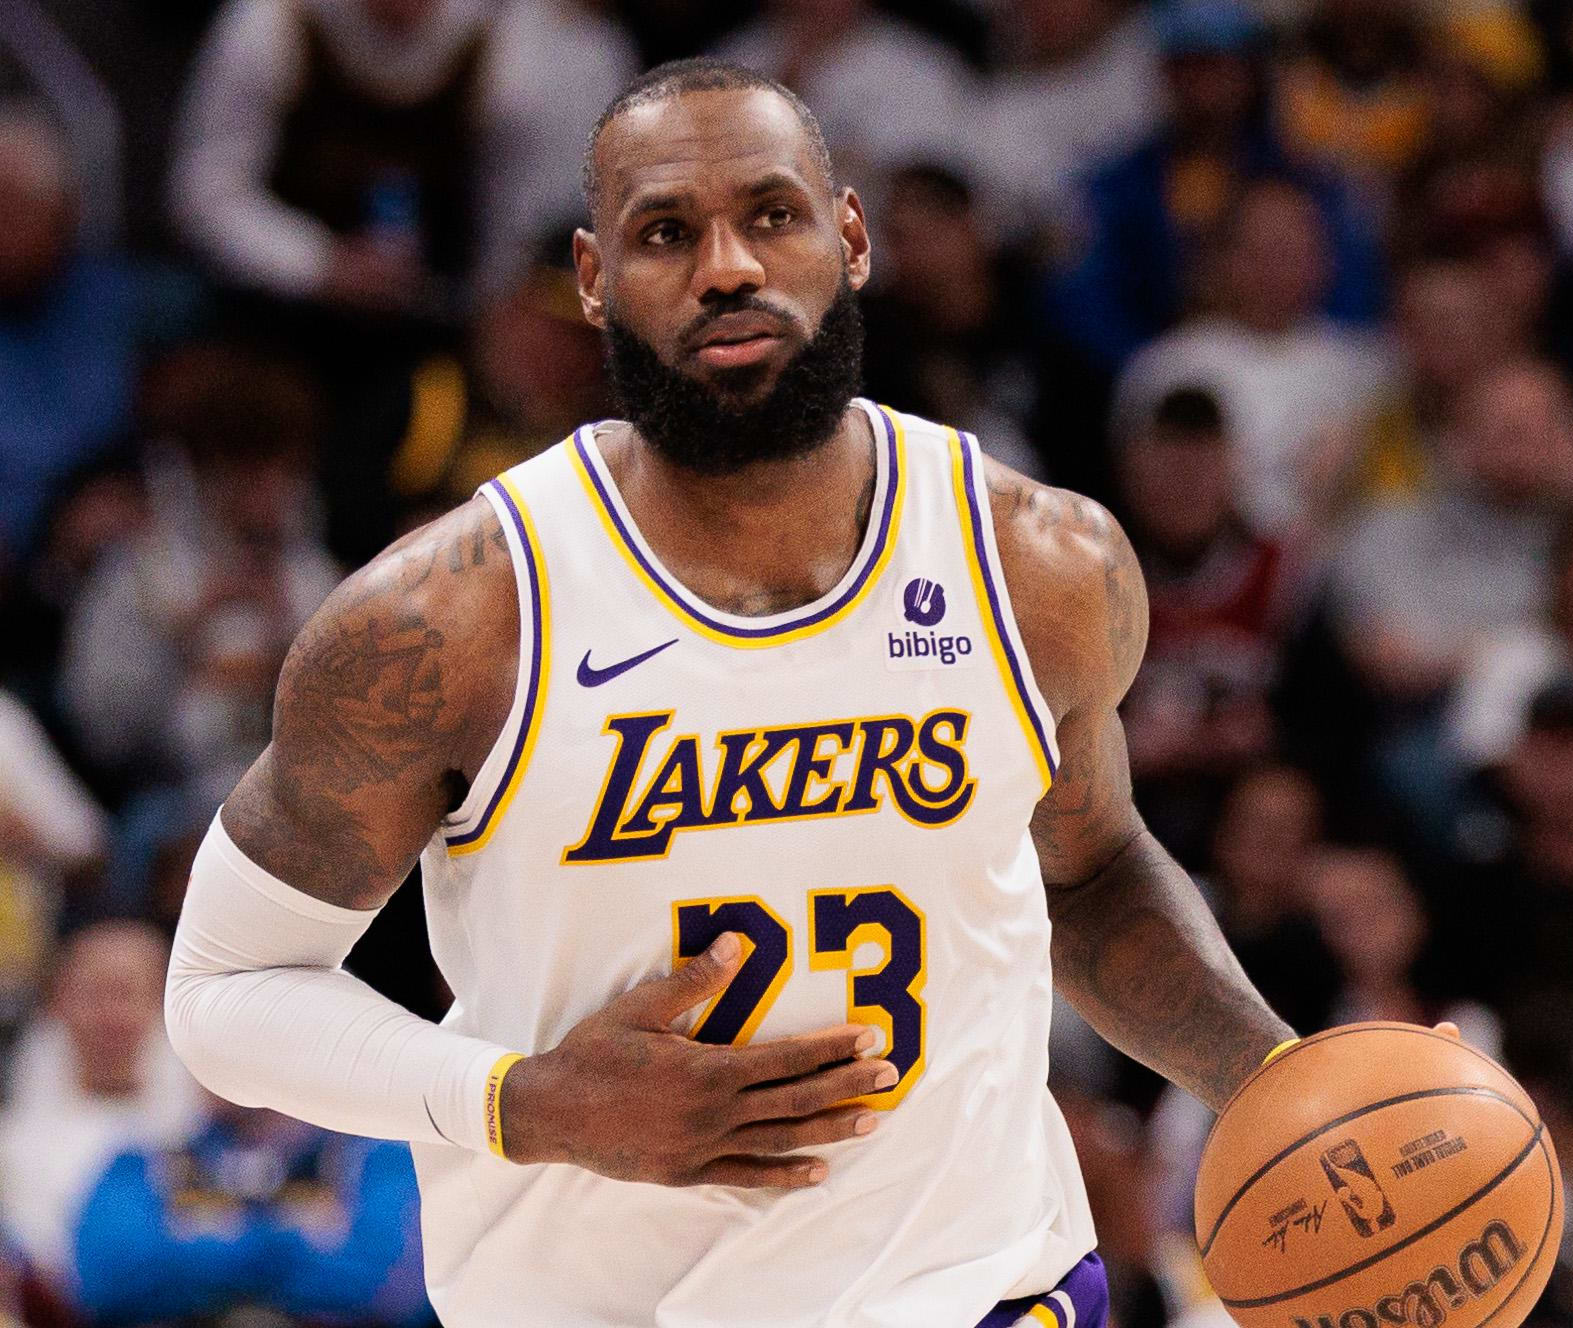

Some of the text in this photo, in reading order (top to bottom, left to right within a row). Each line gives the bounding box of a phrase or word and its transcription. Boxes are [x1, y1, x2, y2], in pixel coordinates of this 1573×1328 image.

[888, 631, 972, 665] bibigo
[560, 707, 979, 866] LAKERS
[671, 884, 927, 1111] 23
[487, 1083, 498, 1144] PROMISE
